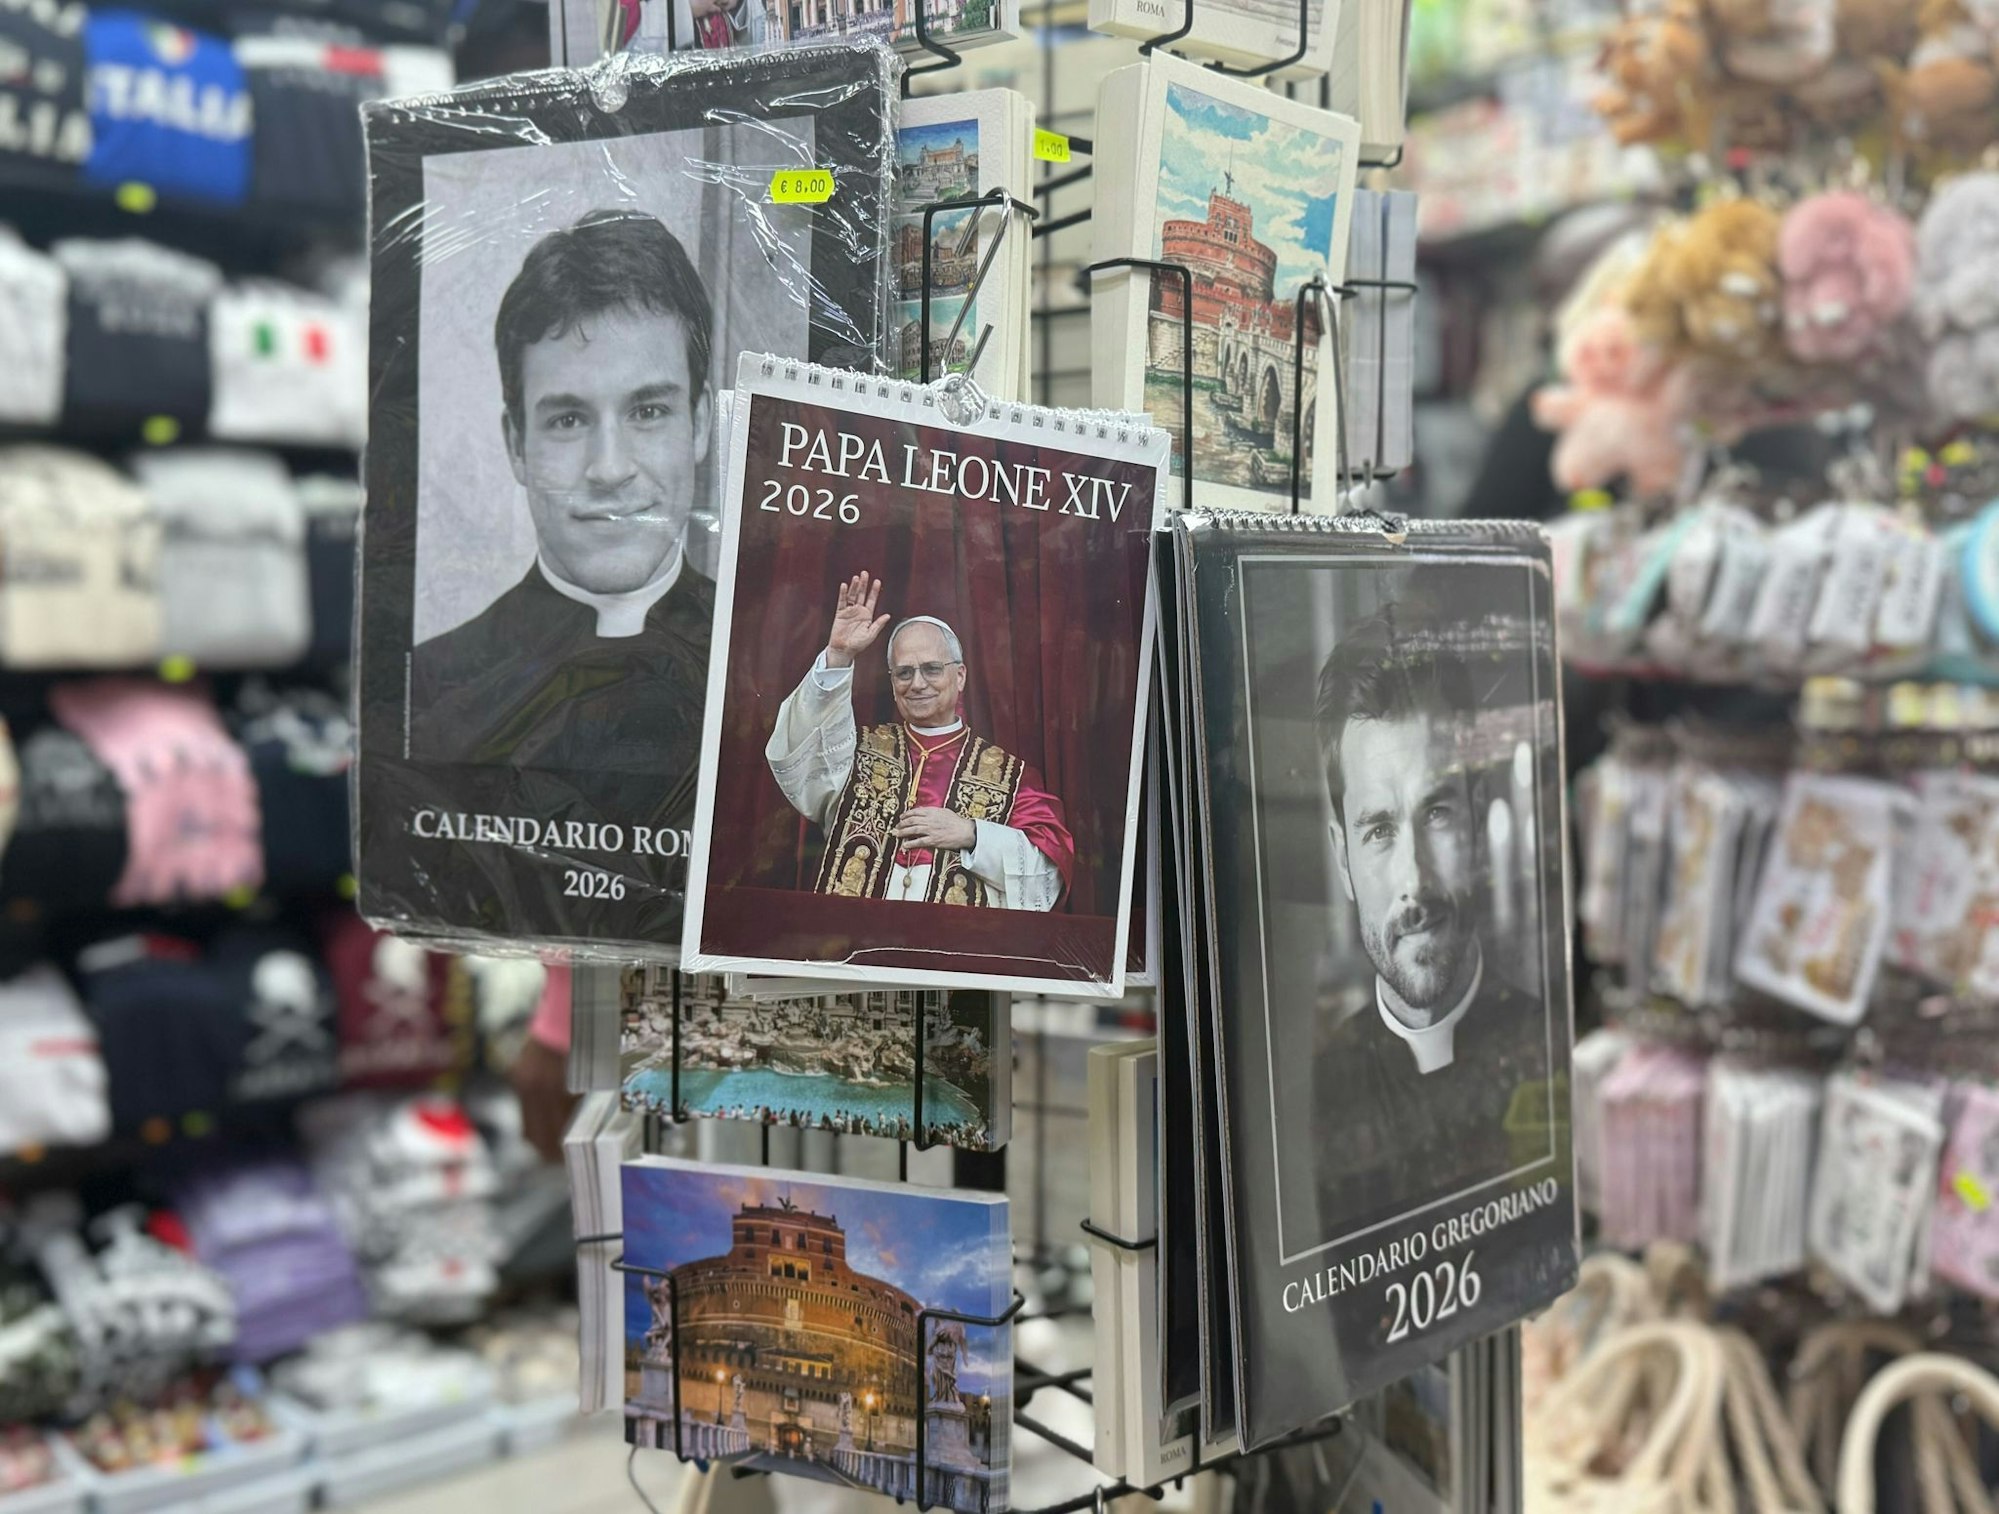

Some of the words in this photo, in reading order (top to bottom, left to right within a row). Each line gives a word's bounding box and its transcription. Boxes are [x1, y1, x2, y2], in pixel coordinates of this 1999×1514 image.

[1136, 0, 1165, 17] ROMA
[781, 180, 788, 193] €
[795, 179, 825, 193] 8,00
[777, 422, 891, 484] PAPA
[900, 444, 1051, 512] LEONE
[1058, 472, 1133, 523] XIV
[759, 480, 861, 524] 2026
[413, 810, 624, 853] CALENDARIO
[563, 870, 626, 900] 2026
[1282, 1232, 1427, 1313] CALENDARIO
[1432, 1177, 1558, 1252] GREGORIANO
[1385, 1250, 1481, 1343] 2026
[1160, 1446, 1187, 1464] ROMA
